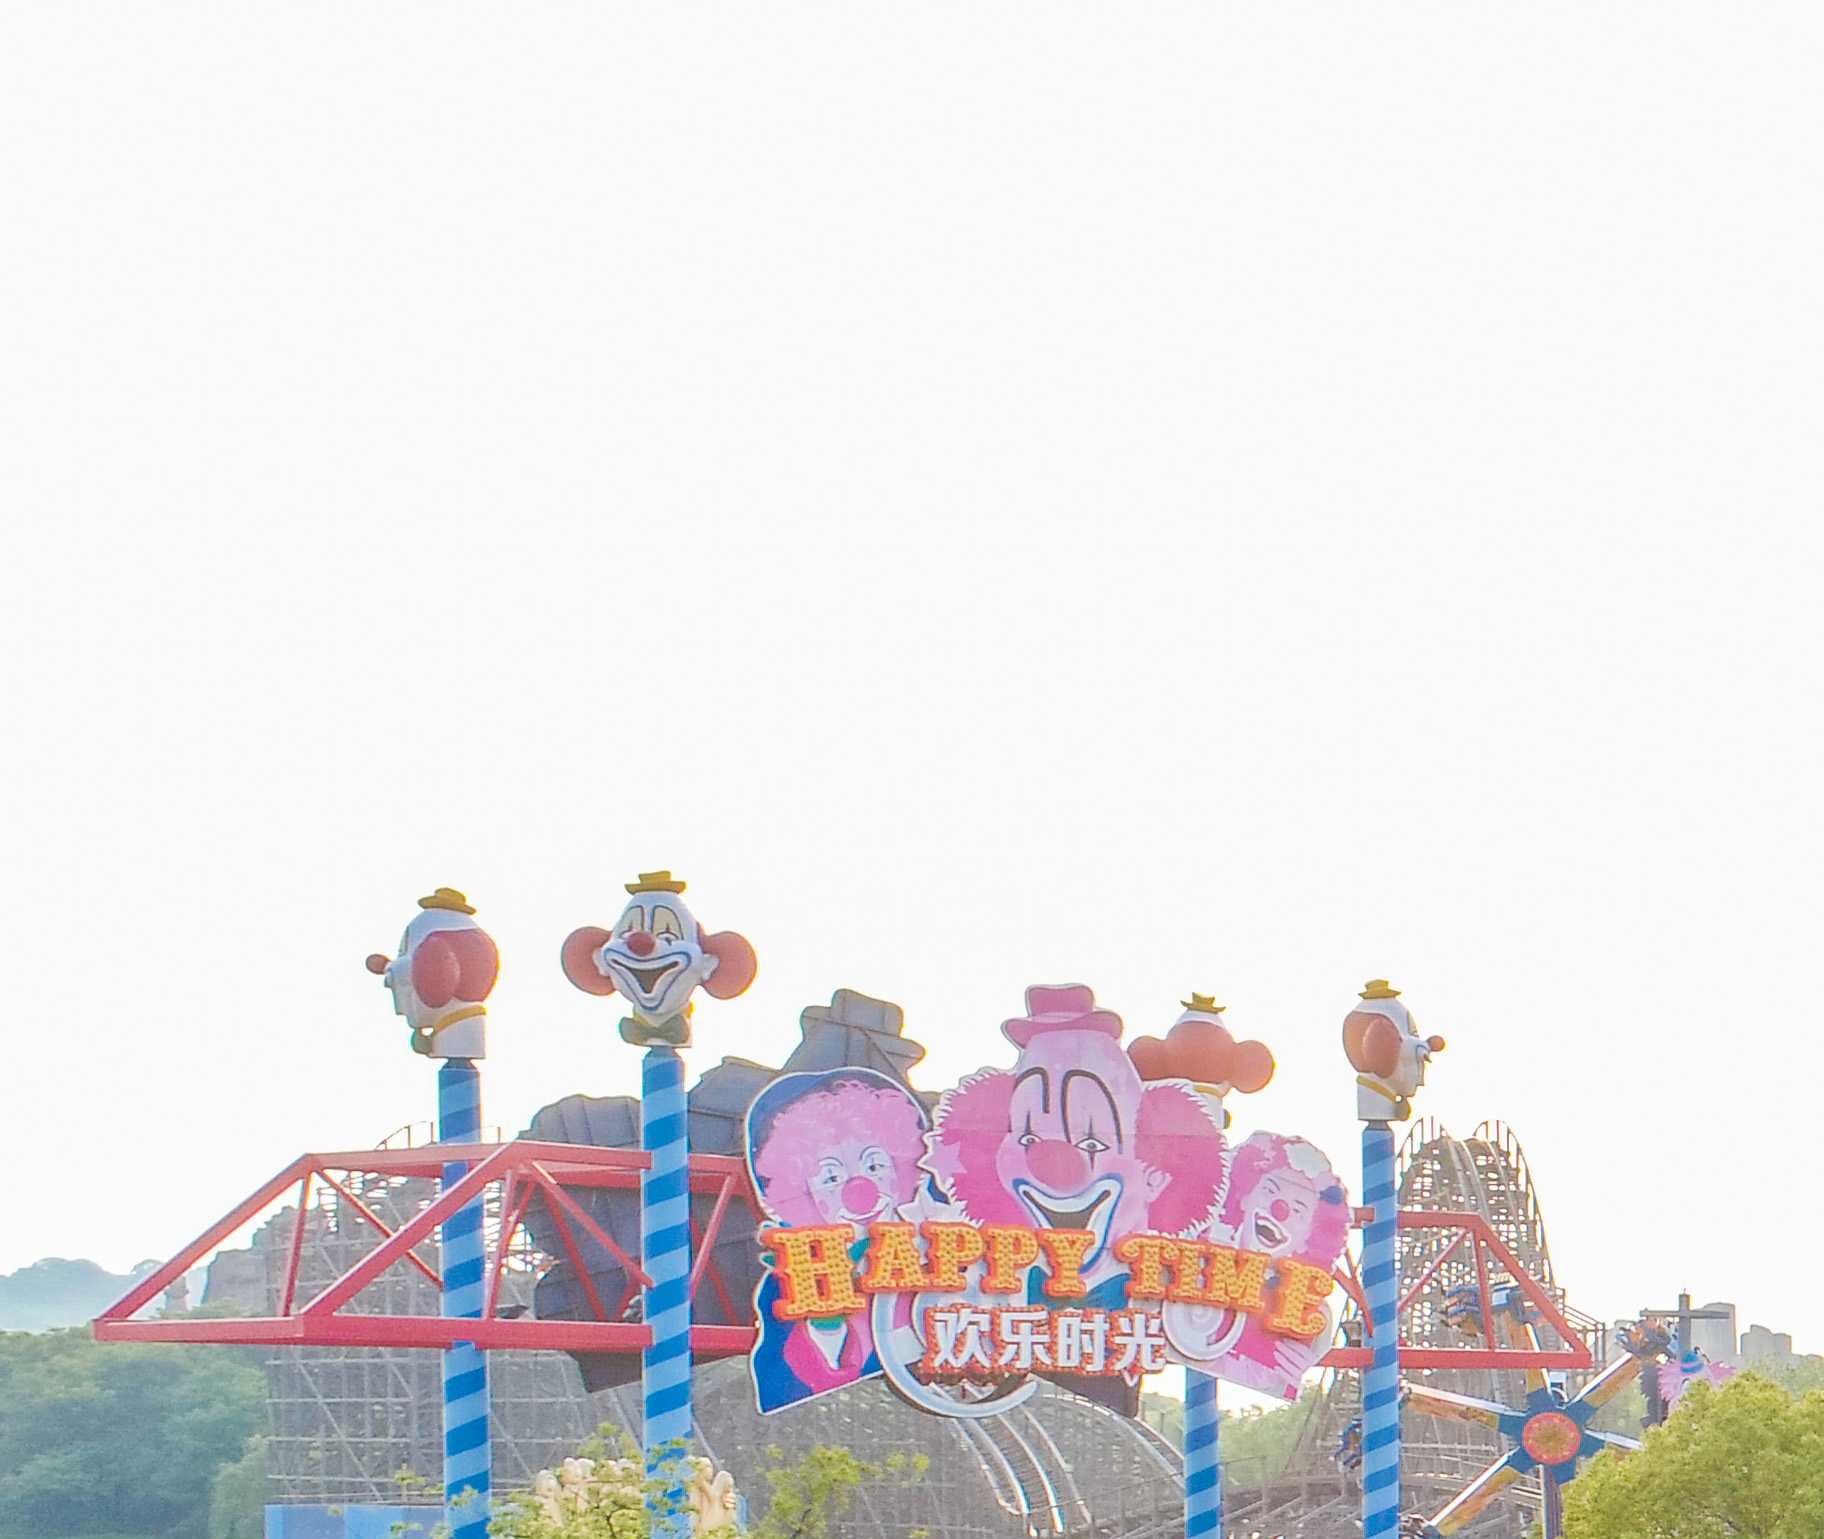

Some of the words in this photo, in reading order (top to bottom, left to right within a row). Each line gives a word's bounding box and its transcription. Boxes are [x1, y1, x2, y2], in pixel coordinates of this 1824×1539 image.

[762, 1222, 1102, 1321] HAPPY
[1117, 1231, 1338, 1341] TIME
[930, 1309, 1168, 1375] 欢乐时光
